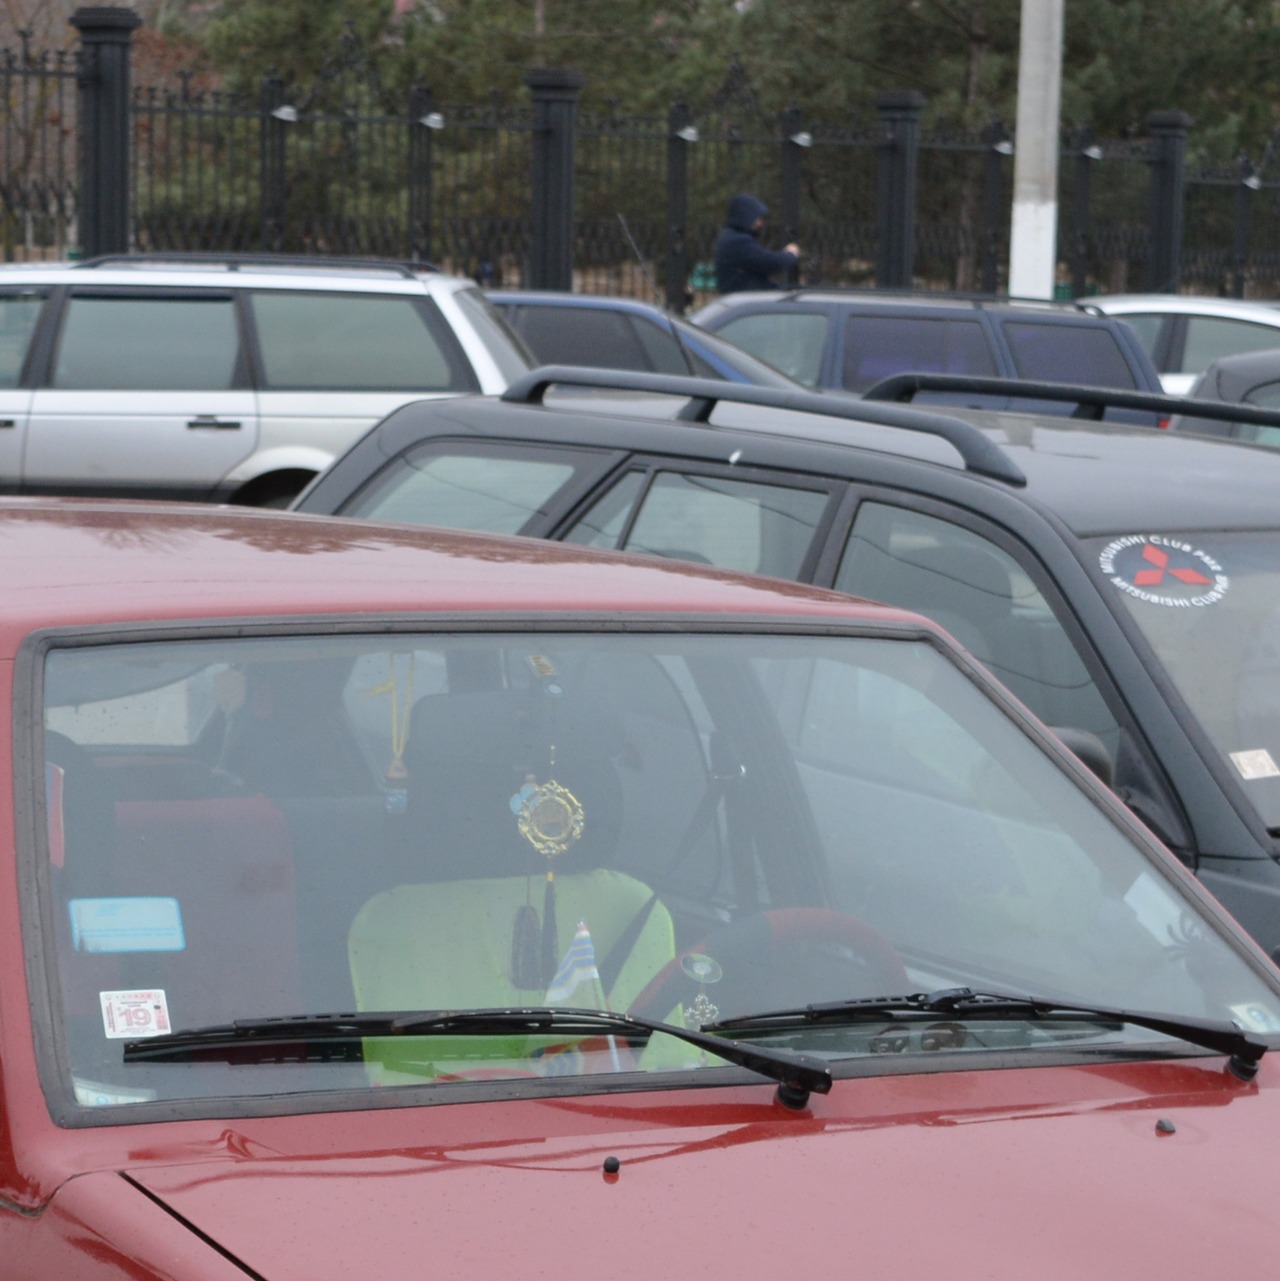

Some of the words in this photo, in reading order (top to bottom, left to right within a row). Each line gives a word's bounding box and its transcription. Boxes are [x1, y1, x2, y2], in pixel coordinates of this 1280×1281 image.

[1099, 534, 1146, 575] MITSUBISHI
[1149, 534, 1193, 553] CLUB
[1110, 576, 1191, 608] MITSUBISHI
[1191, 590, 1223, 607] CLUB
[119, 1007, 151, 1027] 19
